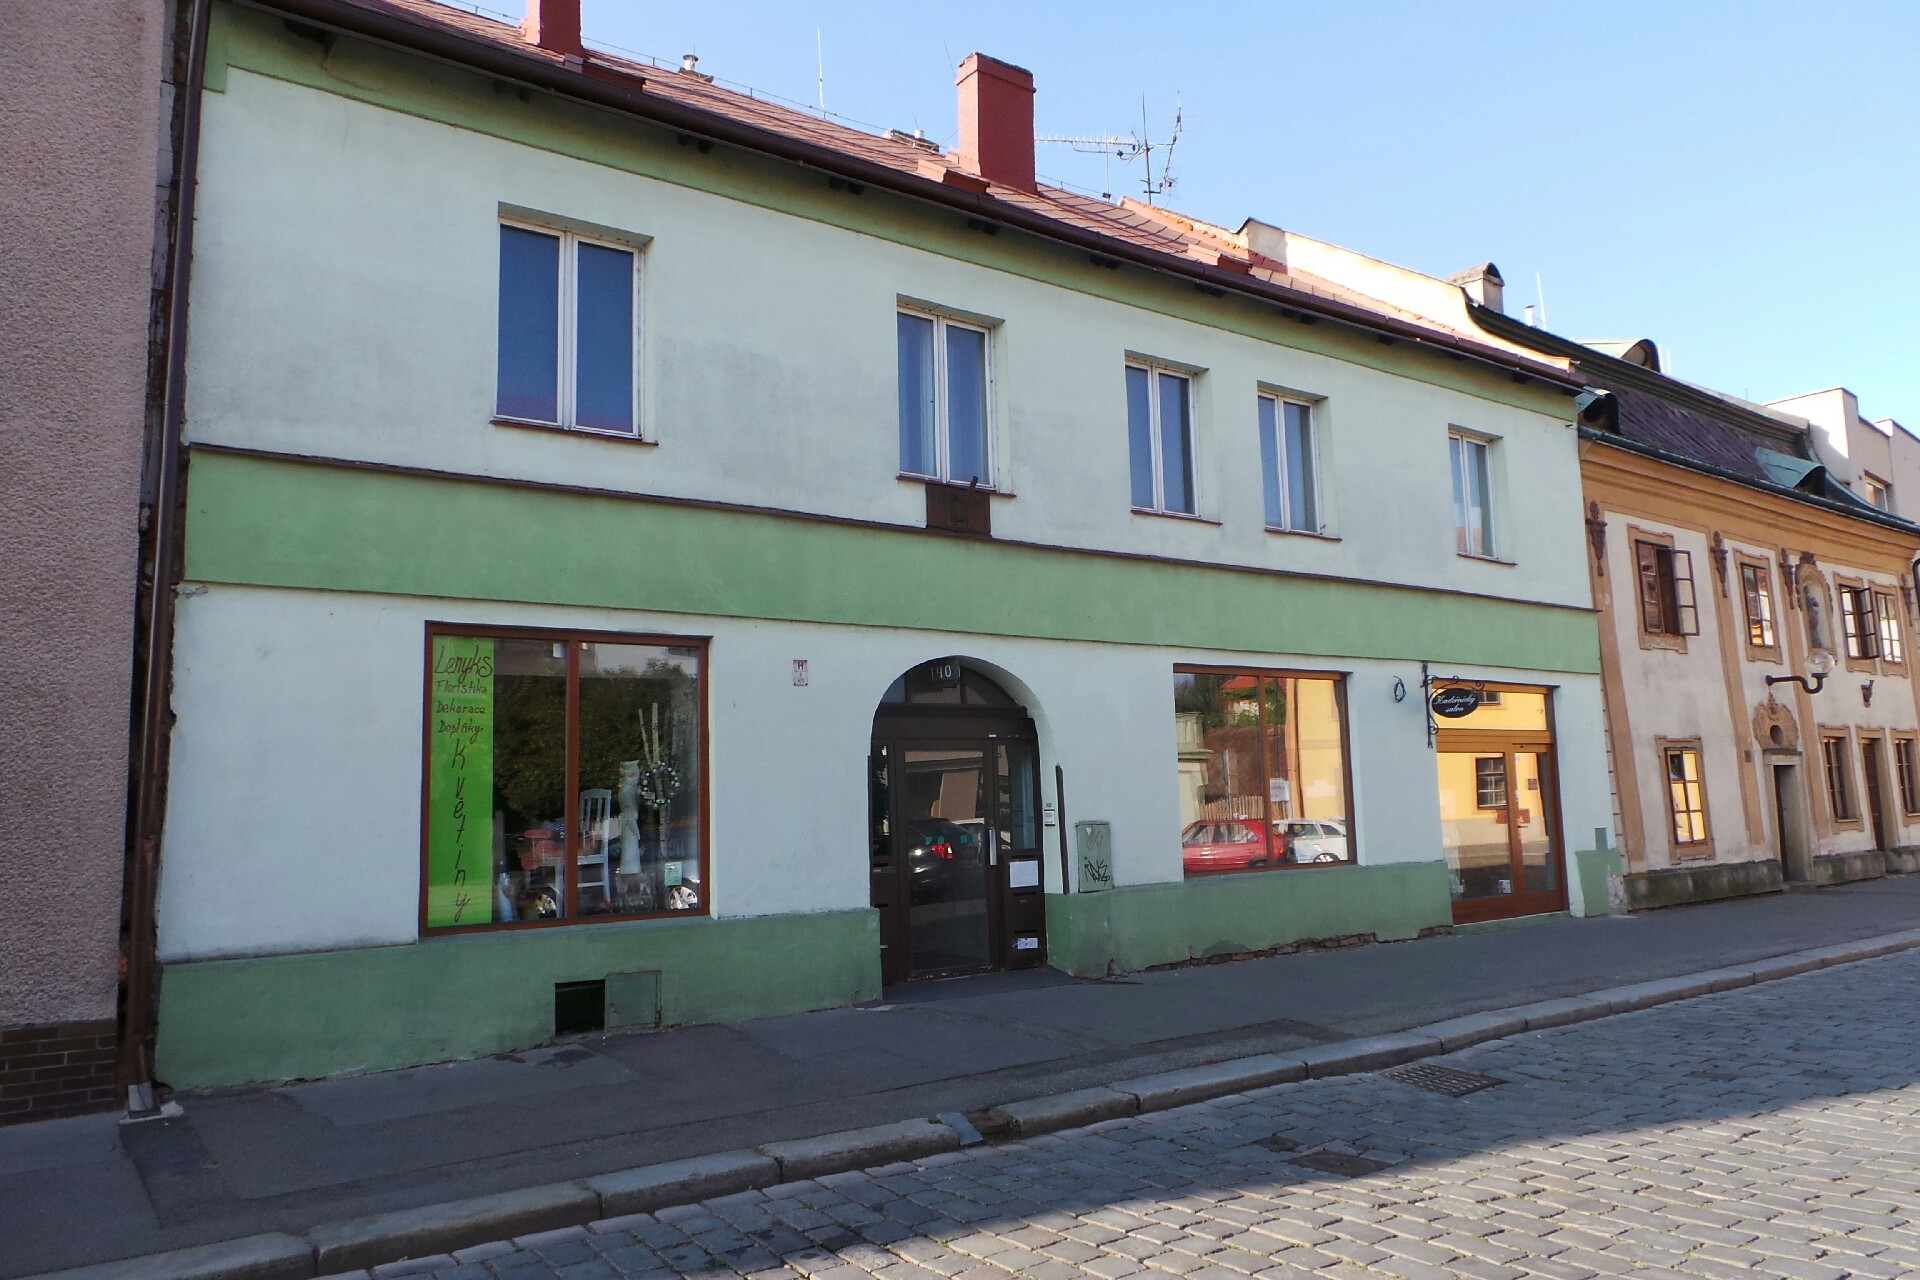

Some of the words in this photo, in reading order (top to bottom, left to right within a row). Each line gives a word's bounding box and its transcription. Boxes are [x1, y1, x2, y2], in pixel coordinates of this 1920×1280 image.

[797, 661, 804, 670] H
[436, 678, 487, 694] Floristika
[436, 698, 486, 714] Dekorace
